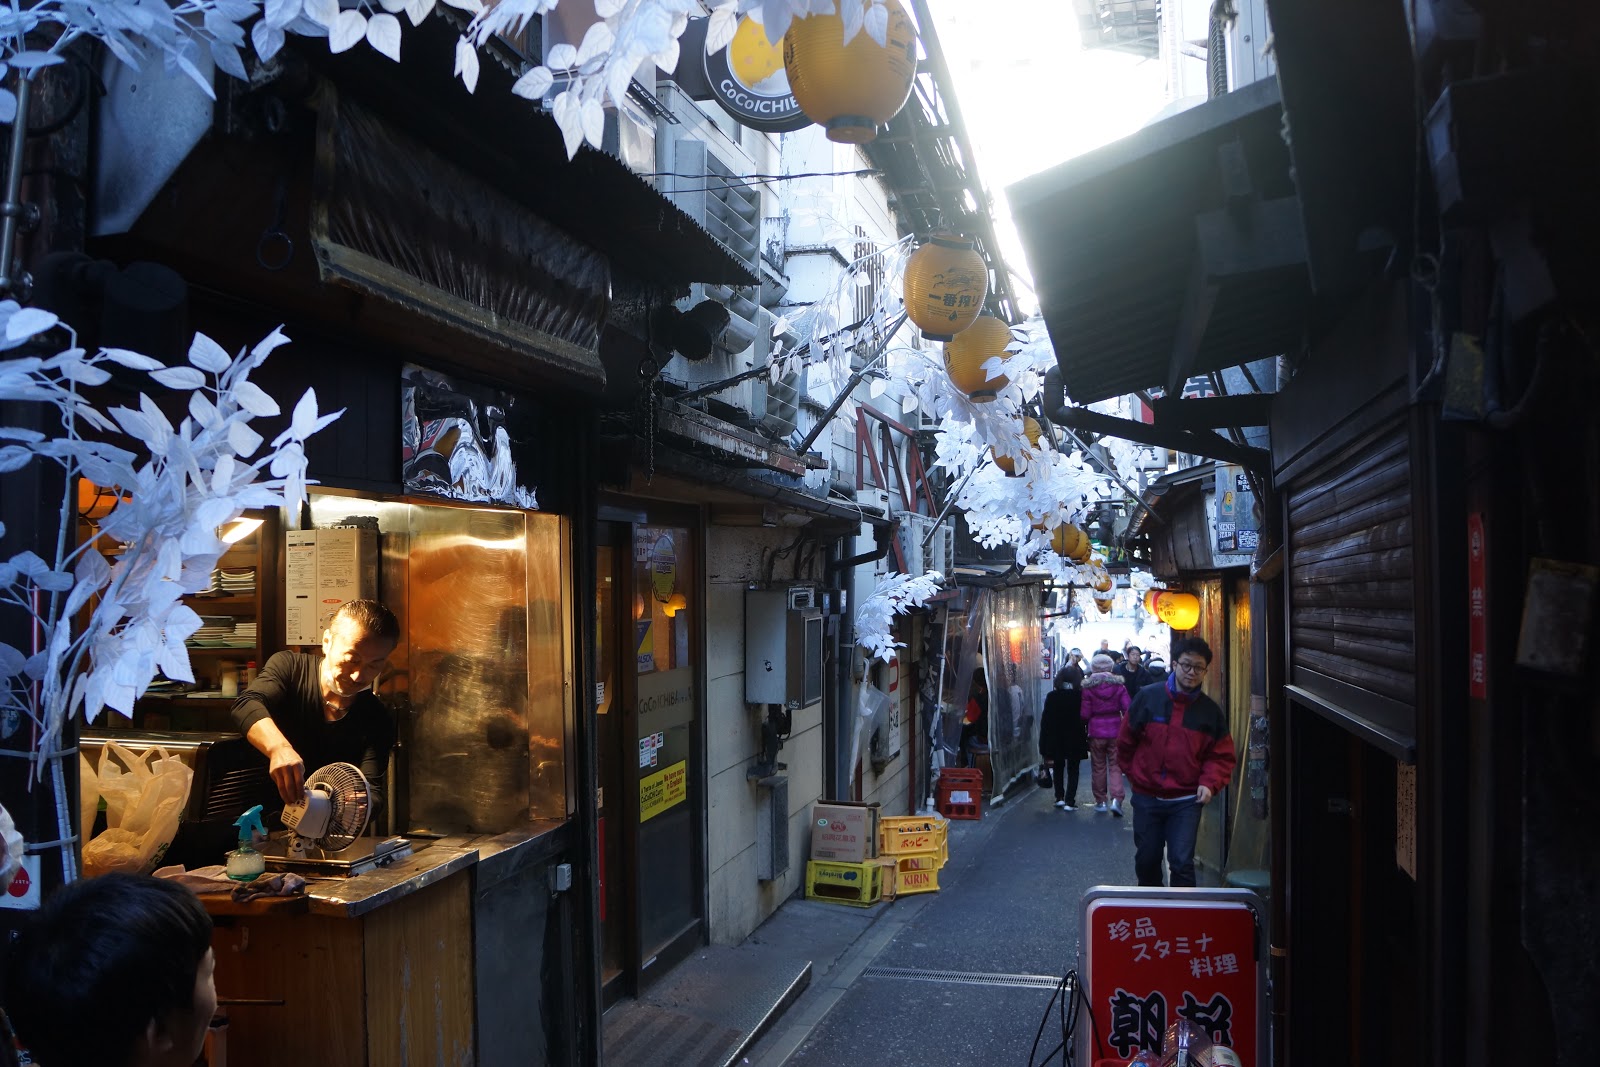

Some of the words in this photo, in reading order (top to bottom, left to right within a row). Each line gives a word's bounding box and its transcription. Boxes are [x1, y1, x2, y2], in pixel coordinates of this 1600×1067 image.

[928, 293, 981, 308] 一番搾り
[904, 873, 929, 885] KIRIN
[1107, 916, 1157, 942] 珍品
[1131, 933, 1213, 962] スタミナ
[1189, 952, 1239, 978] 料理
